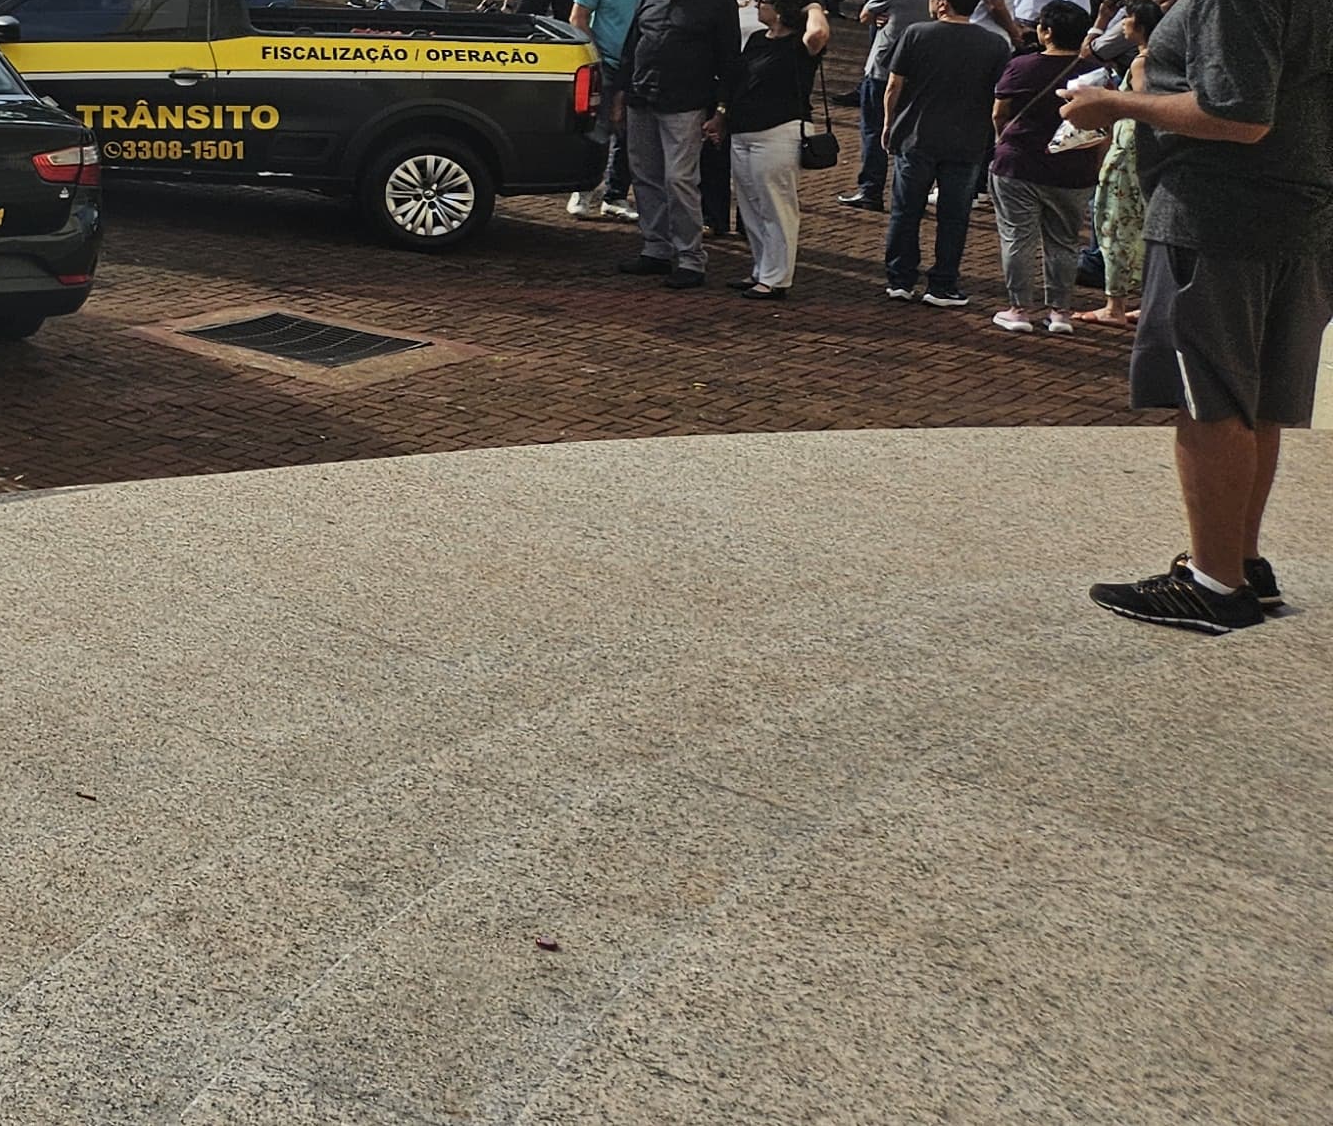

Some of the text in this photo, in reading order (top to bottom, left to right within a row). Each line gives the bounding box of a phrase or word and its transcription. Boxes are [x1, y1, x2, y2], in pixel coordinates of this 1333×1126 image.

[261, 45, 409, 64] FISCALIZAÇÃO
[425, 48, 540, 66] OPERAÇÃO
[75, 99, 281, 130] TRÂNSITO
[121, 139, 245, 161] 3308-1501
